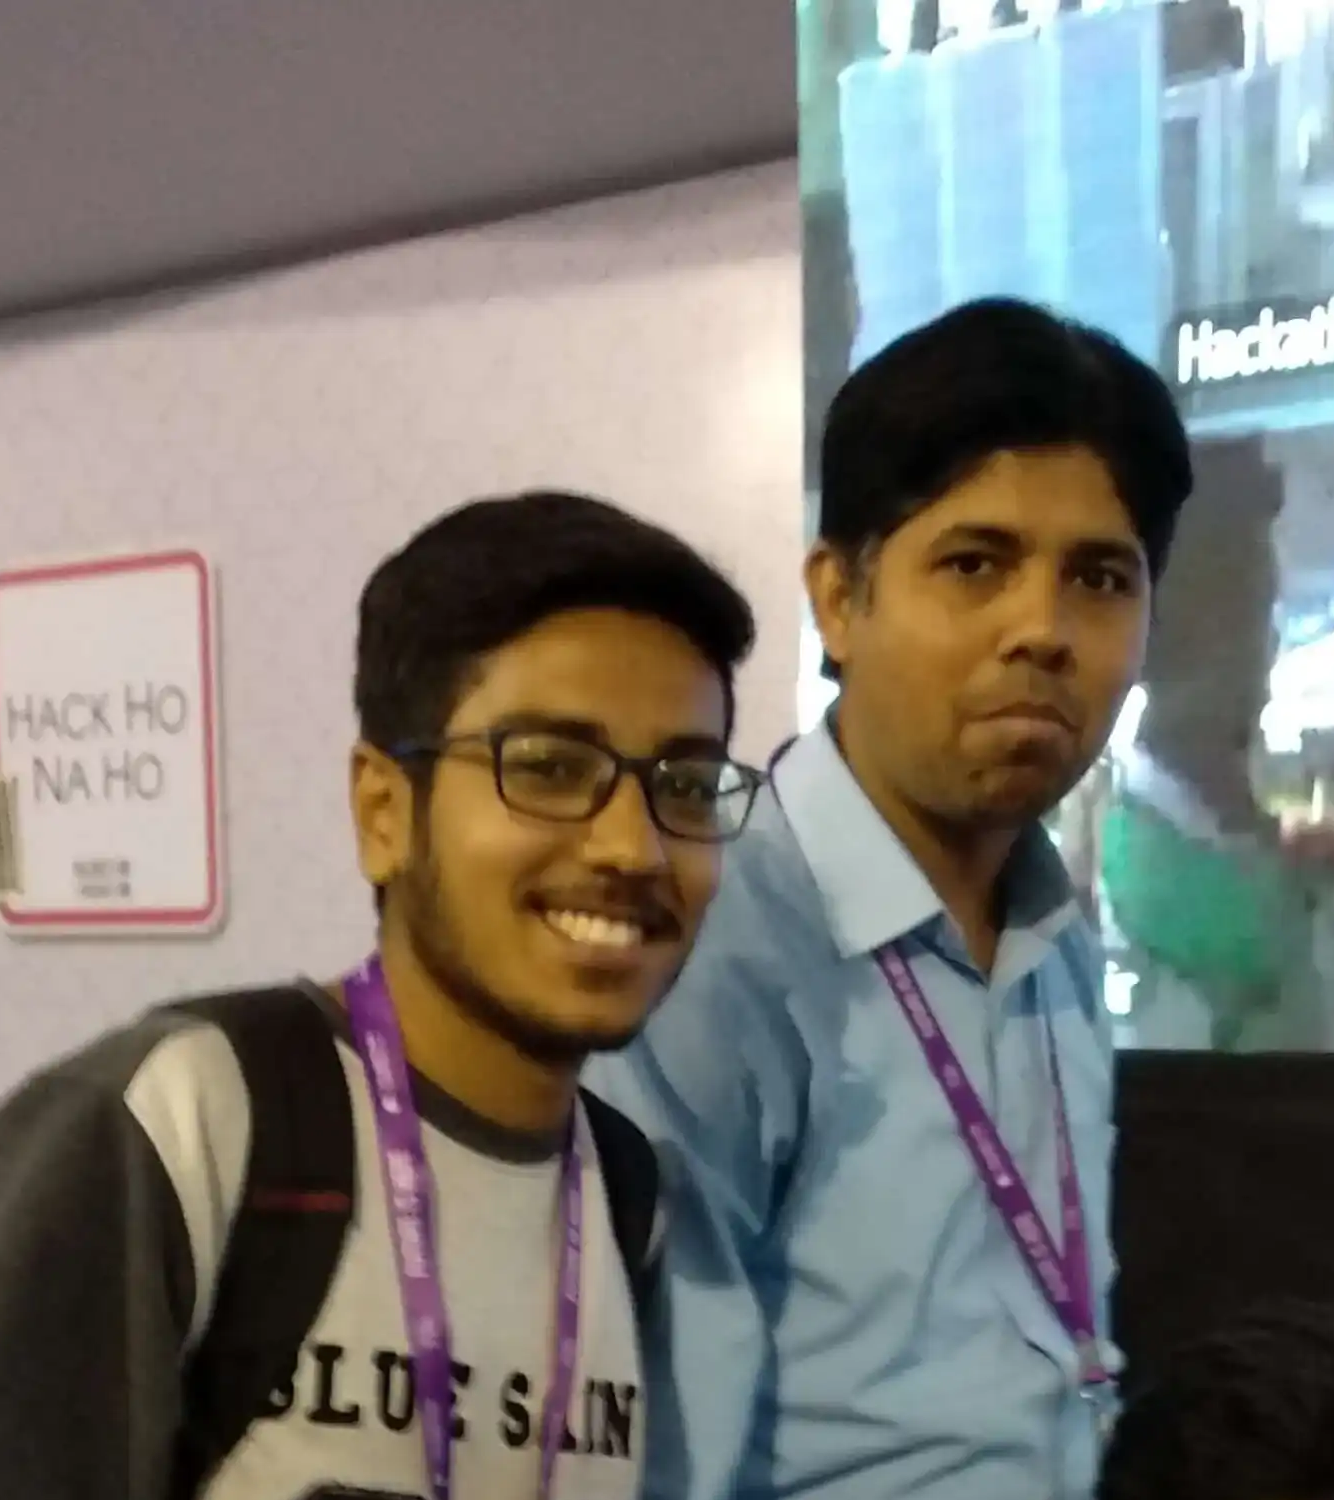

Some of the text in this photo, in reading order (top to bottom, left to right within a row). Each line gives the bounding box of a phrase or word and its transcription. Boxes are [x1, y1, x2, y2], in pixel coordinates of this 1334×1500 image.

[5, 681, 187, 742] HACK HO
[31, 750, 165, 806] NA HO
